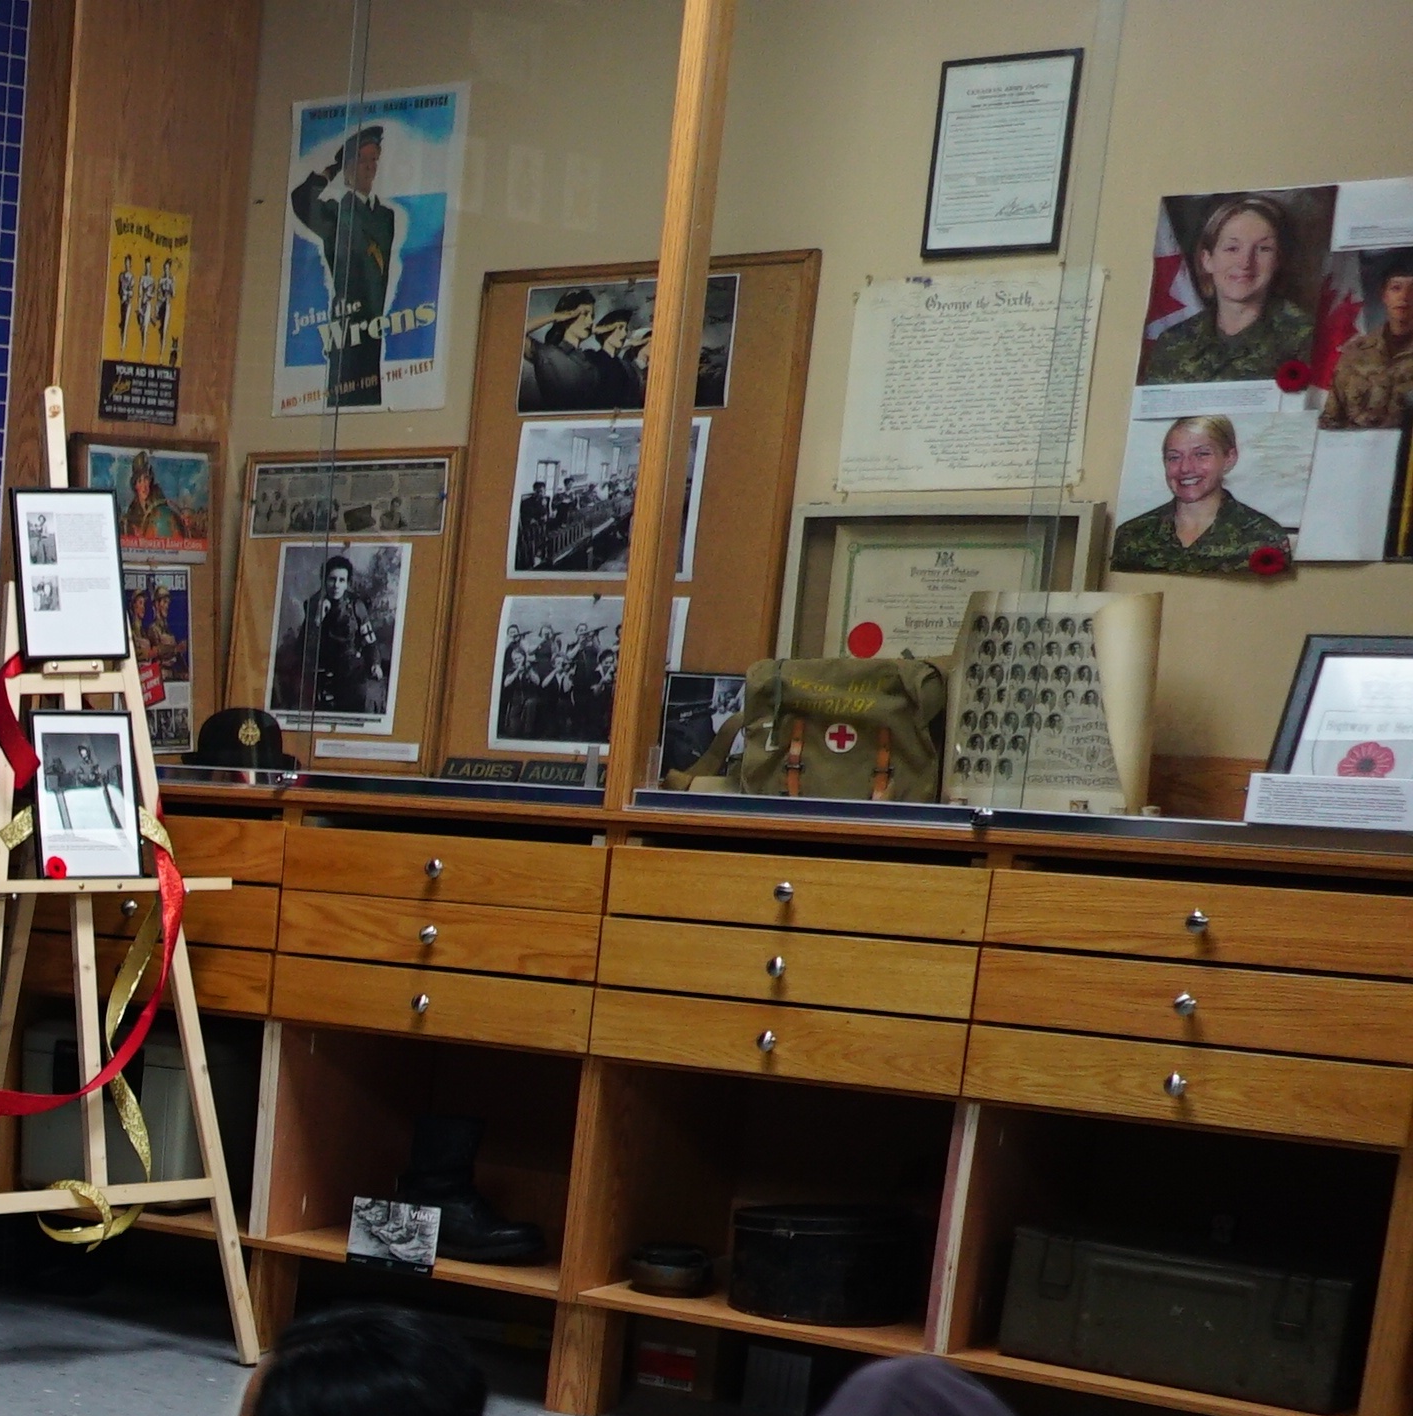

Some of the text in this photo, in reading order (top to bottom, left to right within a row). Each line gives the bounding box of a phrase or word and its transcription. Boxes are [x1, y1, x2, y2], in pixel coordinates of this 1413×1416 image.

[143, 224, 154, 242] the
[156, 234, 172, 252] army
[174, 235, 188, 247] now
[292, 298, 362, 336] join the
[925, 293, 972, 312] George
[318, 301, 436, 353] Wrens
[280, 397, 298, 410] AND
[303, 389, 321, 403] FREE
[360, 375, 378, 390] FOR
[386, 368, 402, 383] THE
[410, 360, 435, 376] FLEET
[447, 762, 515, 778] LADIES
